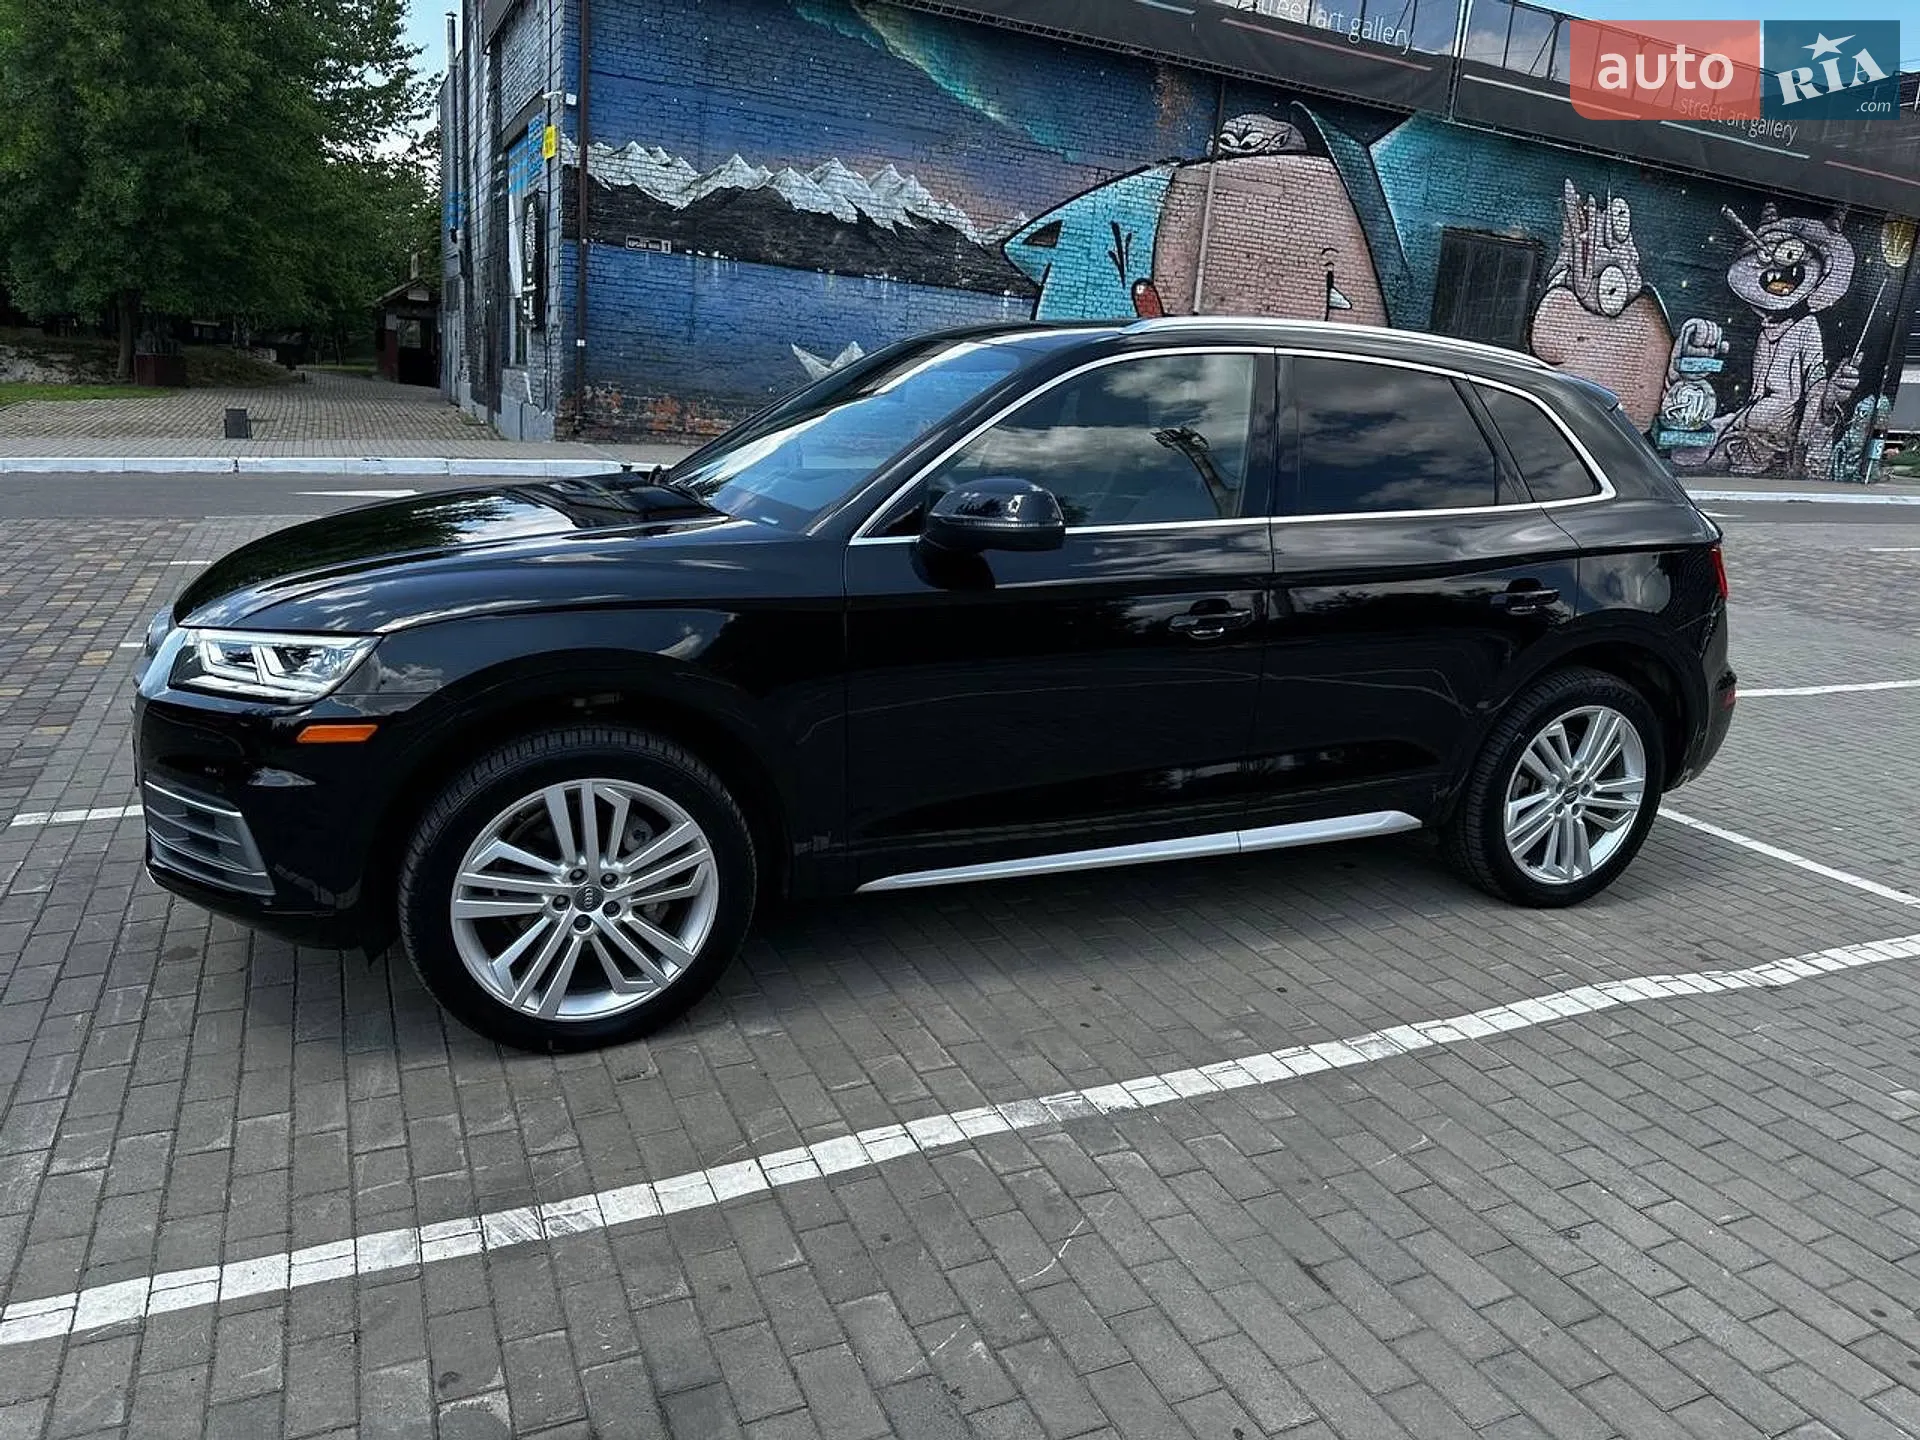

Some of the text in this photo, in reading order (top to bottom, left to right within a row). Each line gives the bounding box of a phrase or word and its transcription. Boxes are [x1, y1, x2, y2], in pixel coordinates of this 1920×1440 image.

[1314, 7, 1344, 33] art
[1348, 16, 1414, 56] gallery
[1679, 97, 1798, 146] street art gallery
